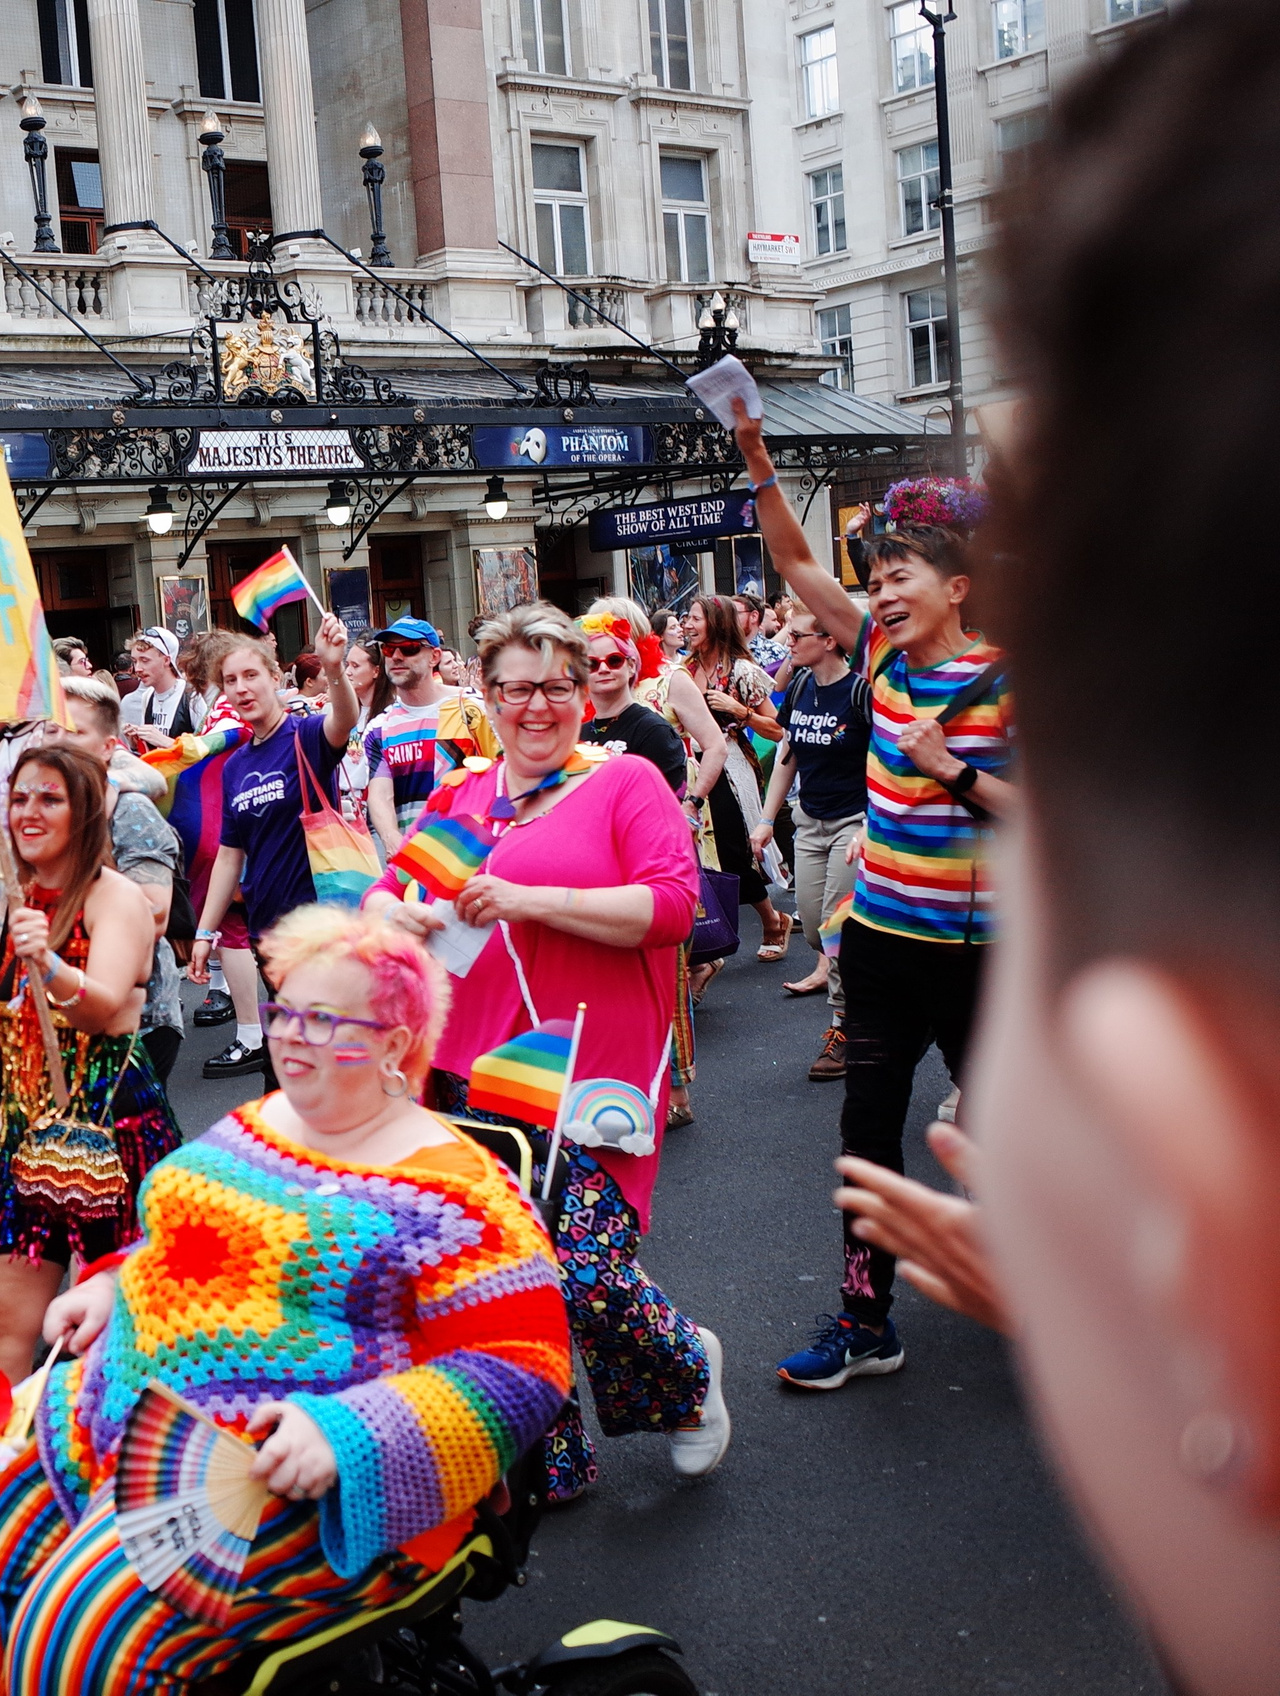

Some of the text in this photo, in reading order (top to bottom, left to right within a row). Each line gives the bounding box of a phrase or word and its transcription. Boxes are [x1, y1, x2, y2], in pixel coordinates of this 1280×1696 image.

[752, 243, 784, 253] HAYMARKET
[260, 433, 292, 445] HIS
[561, 435, 629, 452] PHANTOM
[287, 445, 354, 465] THEATRE
[570, 454, 581, 463] OF
[582, 454, 597, 462] THE
[615, 500, 726, 525] THE BEST WEST END
[617, 522, 649, 536] SHOW
[651, 520, 666, 531] OF
[669, 516, 690, 530] ALL
[794, 728, 832, 745] Hate
[237, 789, 286, 812] AT PRIDE
